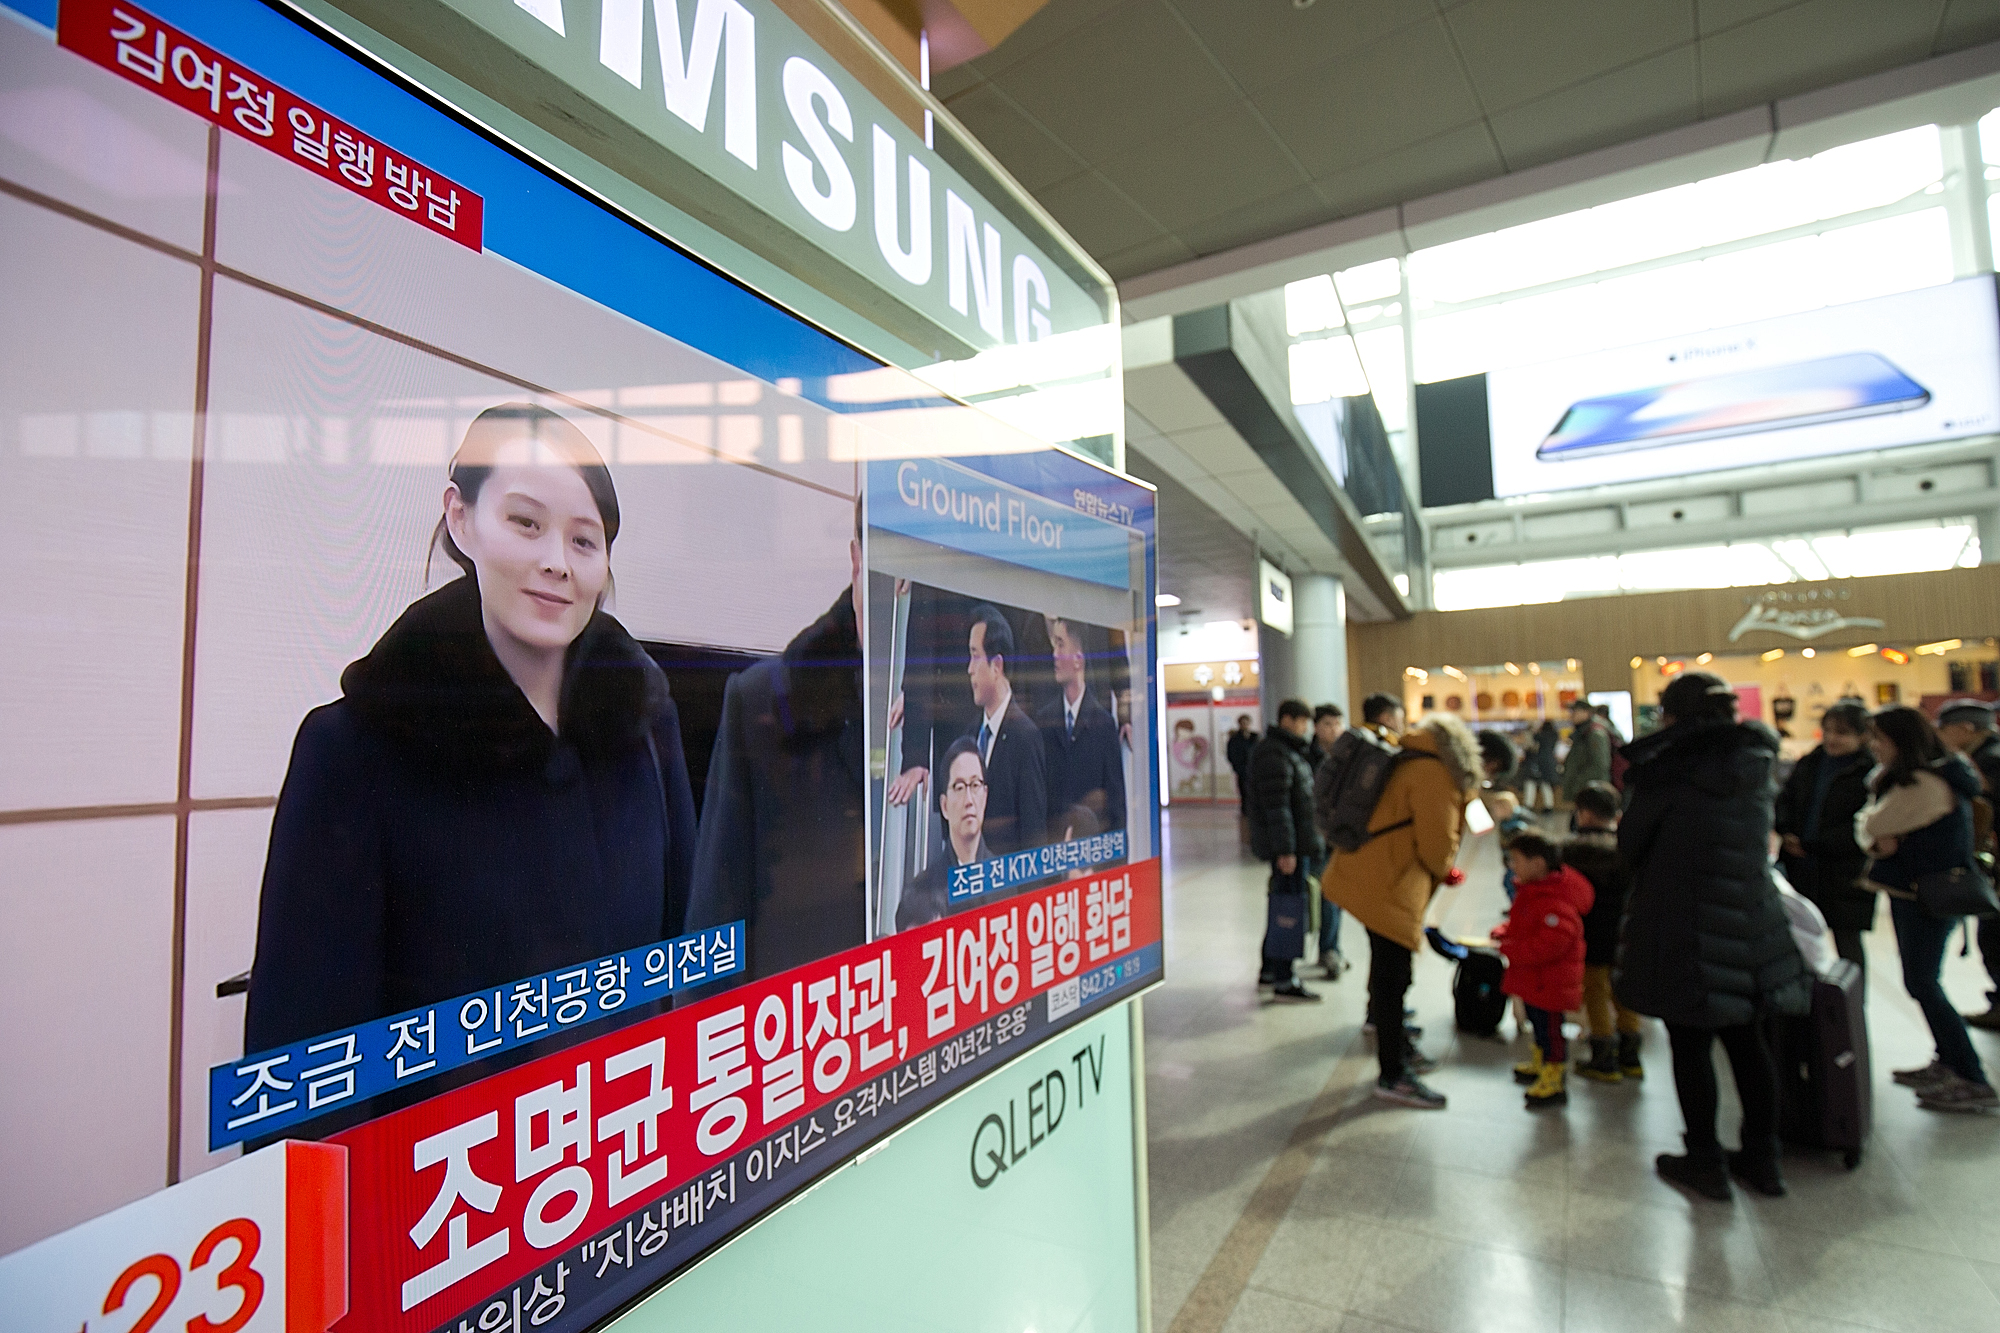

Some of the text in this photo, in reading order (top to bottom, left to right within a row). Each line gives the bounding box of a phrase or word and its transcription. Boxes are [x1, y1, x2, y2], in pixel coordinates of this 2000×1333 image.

[110, 8, 461, 232] 김여정 일행 방남
[513, 0, 1052, 346] MSUNG
[897, 461, 1064, 549] Ground Floor
[1073, 488, 1135, 526] 연합뉴스TV
[952, 832, 1124, 897] 조금 전 KTX 인천국제공항역
[226, 926, 736, 1130] 조금 전 인천공항 의전실
[402, 873, 1133, 1313] 조명균 통일장관, 김여정 일행 환담
[970, 1034, 1106, 1190] QLED TV
[580, 1161, 736, 1279] "지상배치
[746, 1117, 827, 1182] 이지스
[831, 1051, 938, 1137] 요격시스템
[940, 1023, 993, 1074] 30년간
